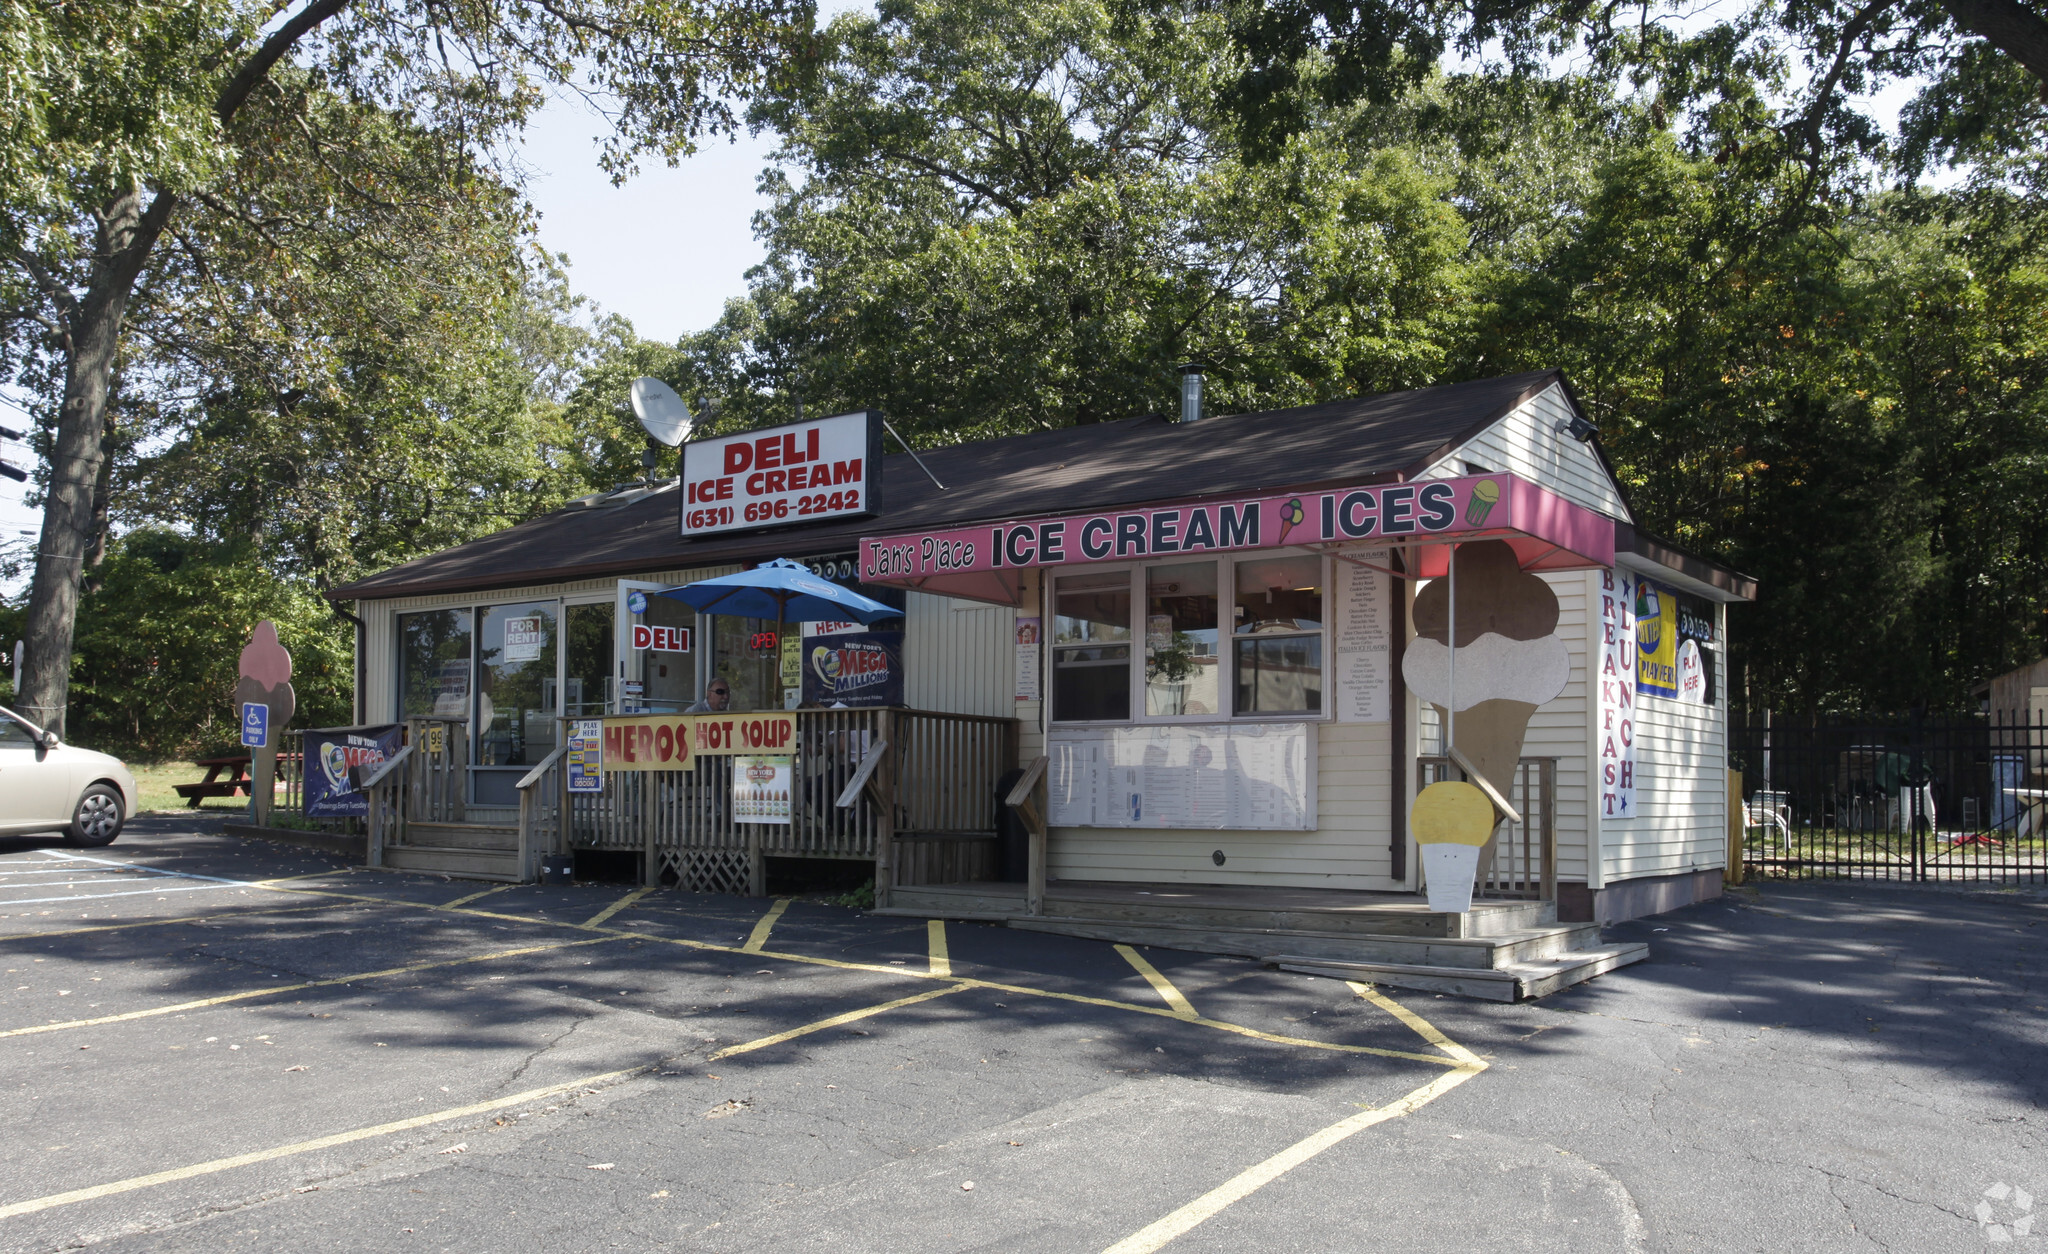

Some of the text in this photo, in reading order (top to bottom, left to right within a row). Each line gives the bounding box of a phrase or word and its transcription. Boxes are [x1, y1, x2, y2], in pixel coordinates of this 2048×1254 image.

[724, 428, 819, 475] DELI
[688, 459, 862, 504] ICE CREAM
[686, 490, 860, 529] (631) 696-2242
[867, 483, 1456, 577] Jan's Place ICE CREAM ICES
[507, 632, 537, 643] RENT
[511, 620, 534, 632] FOR
[633, 625, 689, 652] DELI
[845, 642, 861, 650] NEW
[837, 649, 887, 677] MEGA
[1642, 660, 1659, 680] PLAY
[1683, 655, 1697, 671] PLAY
[834, 671, 888, 693] MILLIONS
[1602, 569, 1617, 815] BREAKFAST
[1684, 675, 1698, 691] HERE
[1619, 601, 1633, 789] LUNCH
[348, 734, 362, 746] NEW
[431, 731, 442, 745] 99
[604, 723, 688, 763] HEROS
[696, 719, 791, 749] HOT SOUP
[318, 802, 338, 810] Drawings
[338, 802, 349, 810] Every
[349, 802, 367, 810] Tuesday
